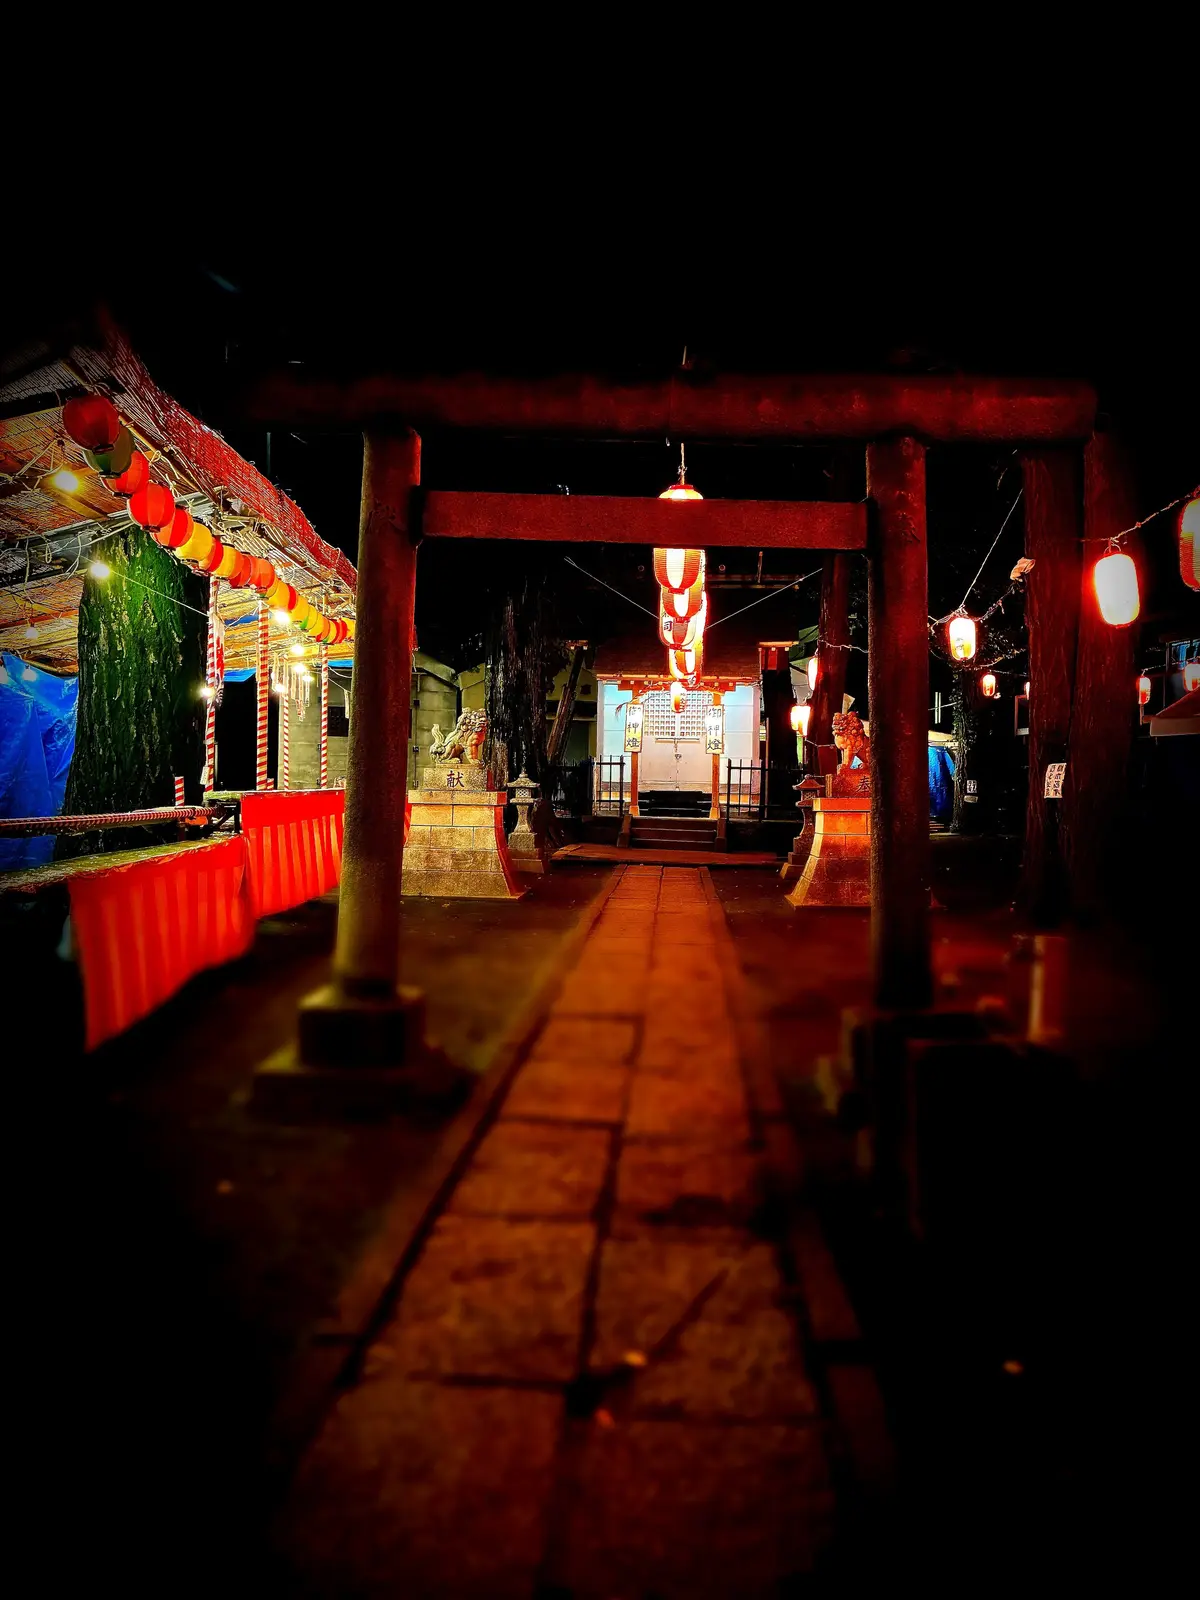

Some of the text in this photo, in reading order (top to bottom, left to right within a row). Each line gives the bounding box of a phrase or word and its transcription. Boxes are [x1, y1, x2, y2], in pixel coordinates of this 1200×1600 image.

[707, 708, 722, 750] 御神燈
[446, 769, 465, 788] 献
